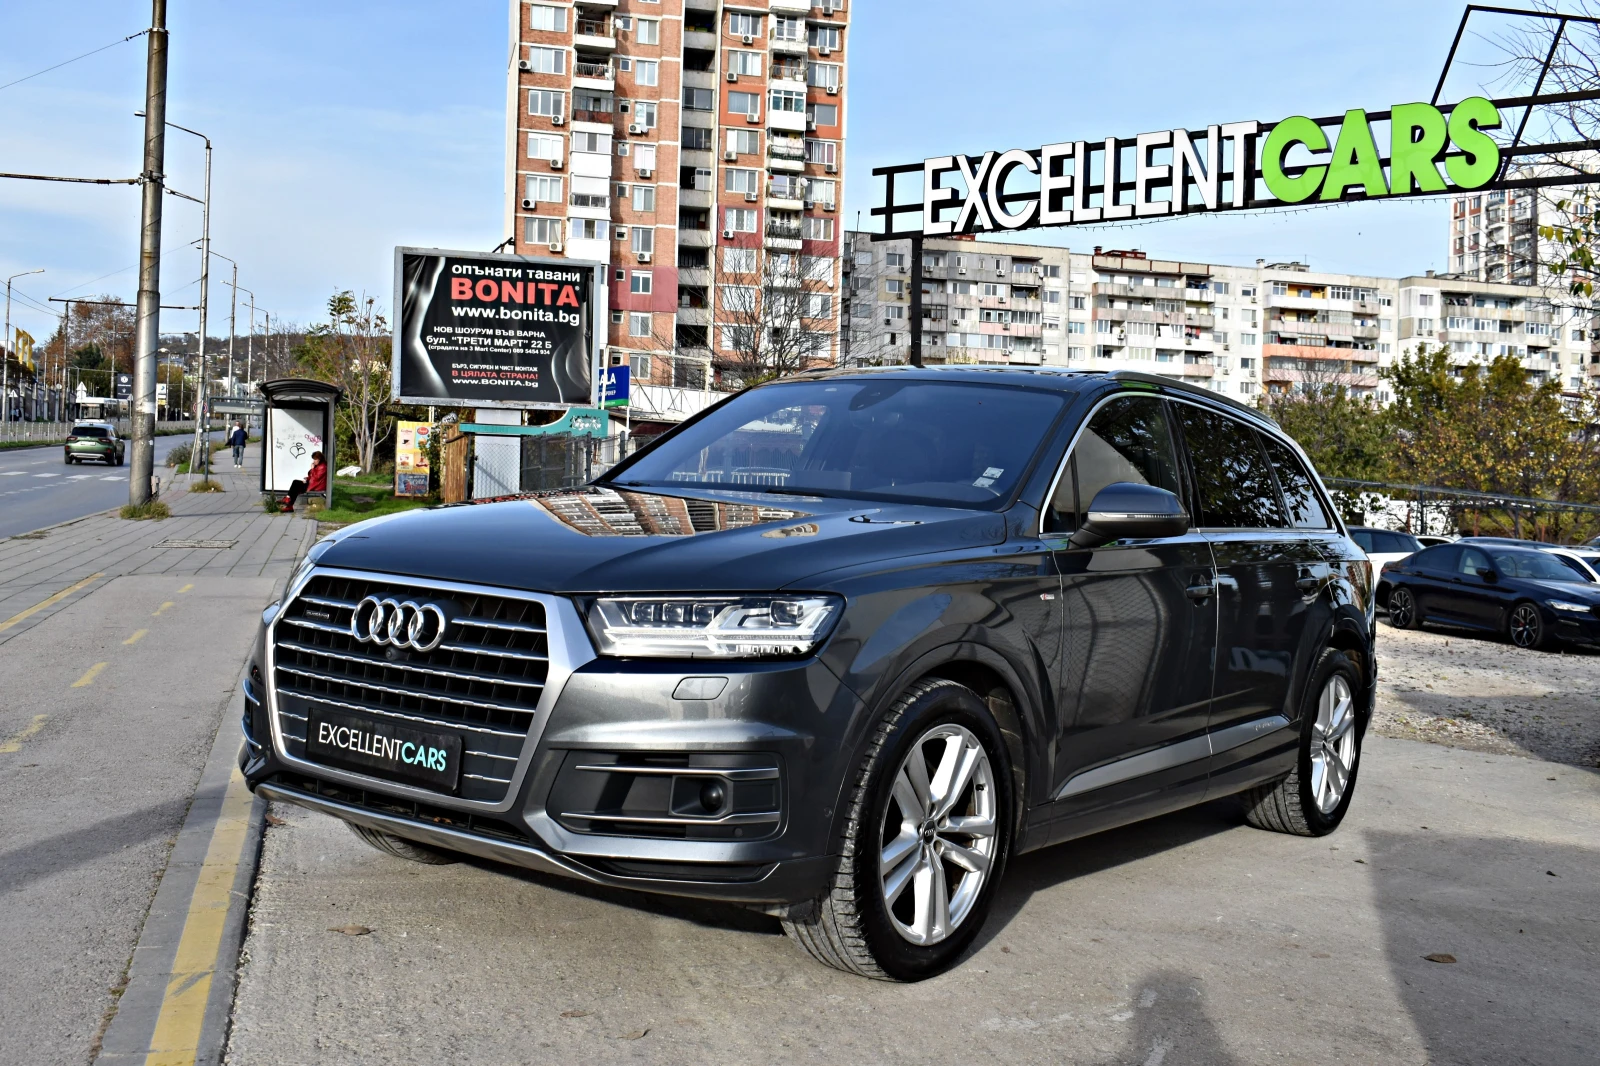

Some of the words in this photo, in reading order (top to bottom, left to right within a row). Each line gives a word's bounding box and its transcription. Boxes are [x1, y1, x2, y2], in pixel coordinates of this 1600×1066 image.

[923, 97, 1501, 235] EXCELLENTCARS
[452, 264, 522, 278] опънати
[527, 269, 580, 282] тавани
[451, 277, 580, 307] BONITA
[452, 306, 580, 326] www.bonita.bg
[455, 327, 493, 335] ШОУРУМ
[495, 328, 514, 336] ВЪВ
[516, 329, 546, 338] ВАРНА
[426, 335, 449, 345] бул.
[531, 340, 543, 349] 22
[545, 341, 552, 349] Б
[489, 346, 512, 354] Center)
[452, 378, 539, 388] www.BONITA.bg
[461, 370, 498, 378] ЦЯЛАТА
[499, 372, 538, 380] СТРАНА!
[318, 722, 447, 772] EXCELLENTCARS
